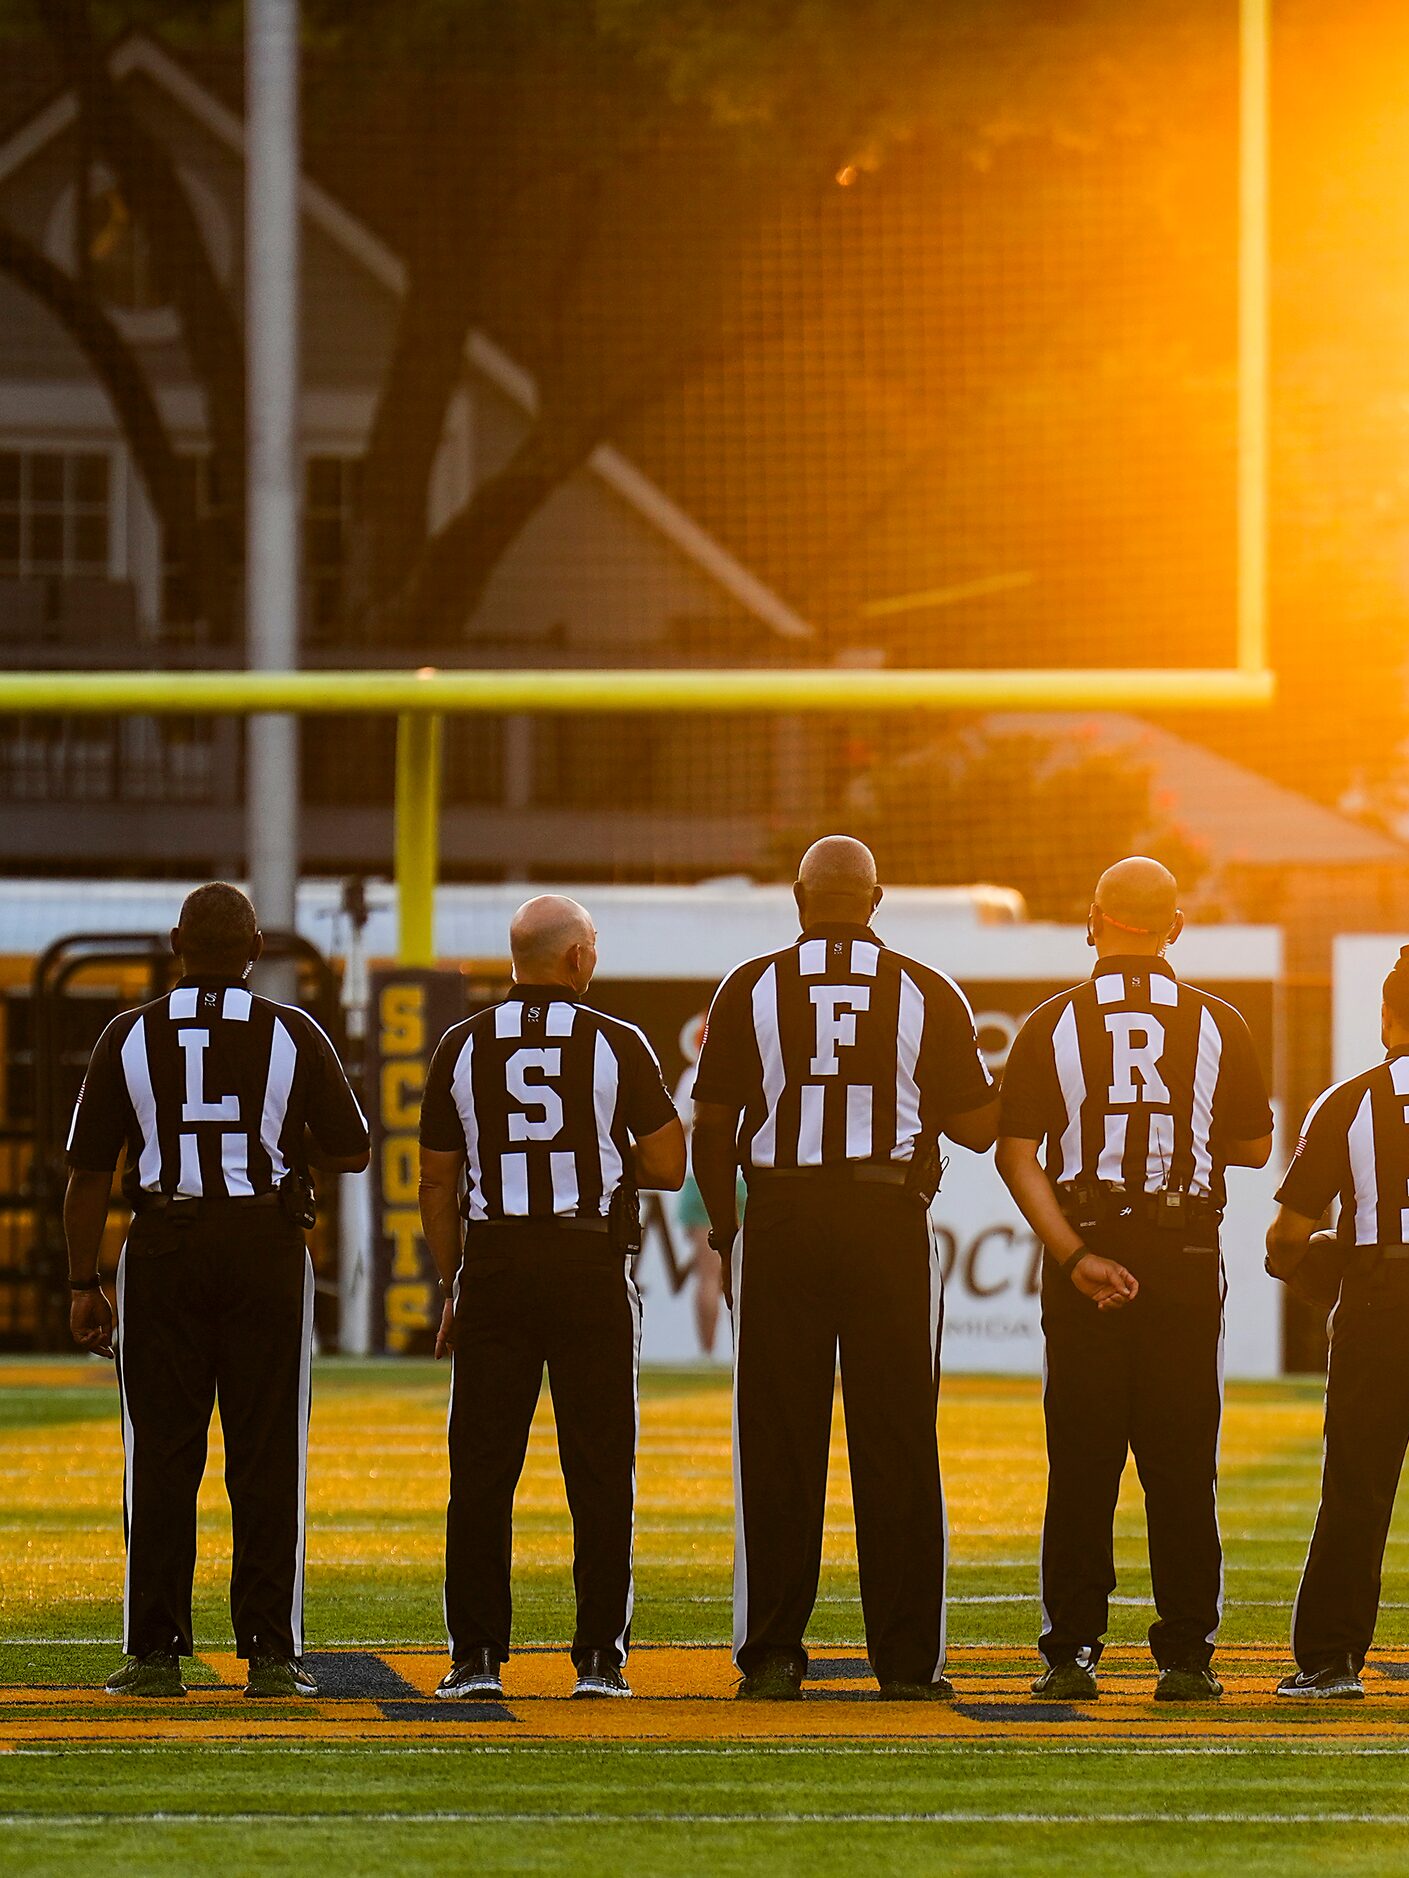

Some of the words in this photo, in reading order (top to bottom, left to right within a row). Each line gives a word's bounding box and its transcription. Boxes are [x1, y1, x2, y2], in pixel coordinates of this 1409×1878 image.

[178, 1028, 241, 1122] L
[810, 985, 870, 1076] F
[1104, 1012, 1170, 1104] R
[506, 1047, 564, 1141] S
